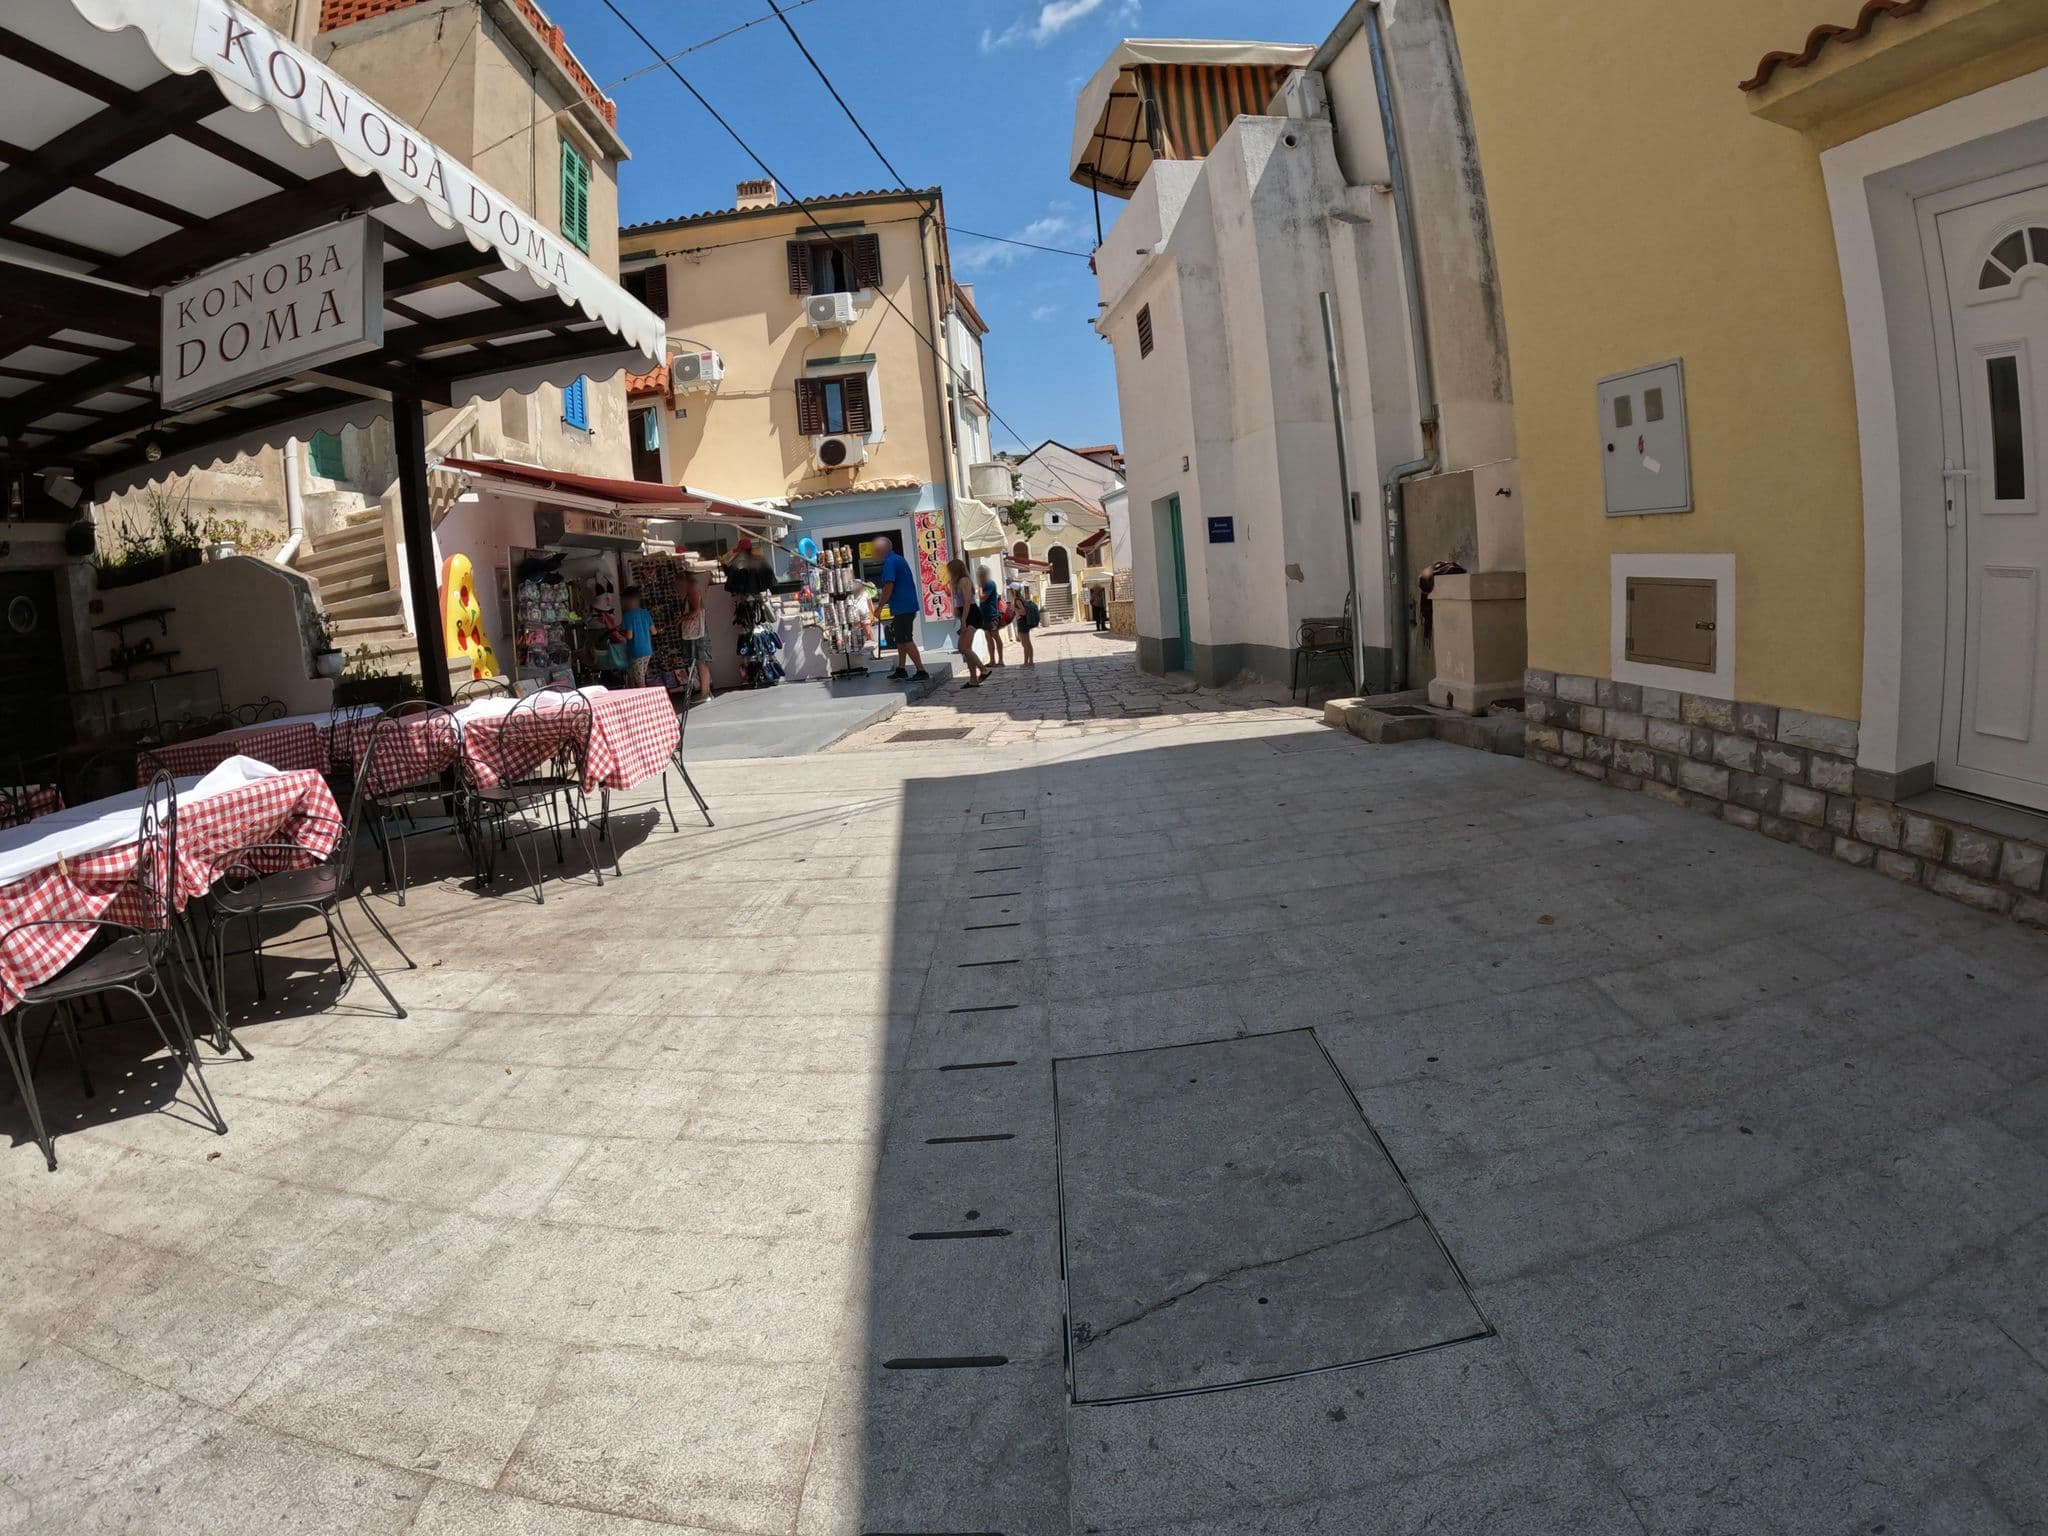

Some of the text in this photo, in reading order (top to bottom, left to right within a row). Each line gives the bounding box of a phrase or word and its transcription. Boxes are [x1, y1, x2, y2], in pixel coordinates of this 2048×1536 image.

[217, 12, 570, 286] KONOBA DOMA
[176, 244, 344, 330] KONOBA
[175, 288, 346, 381] DOMA
[608, 520, 627, 536] SHOP
